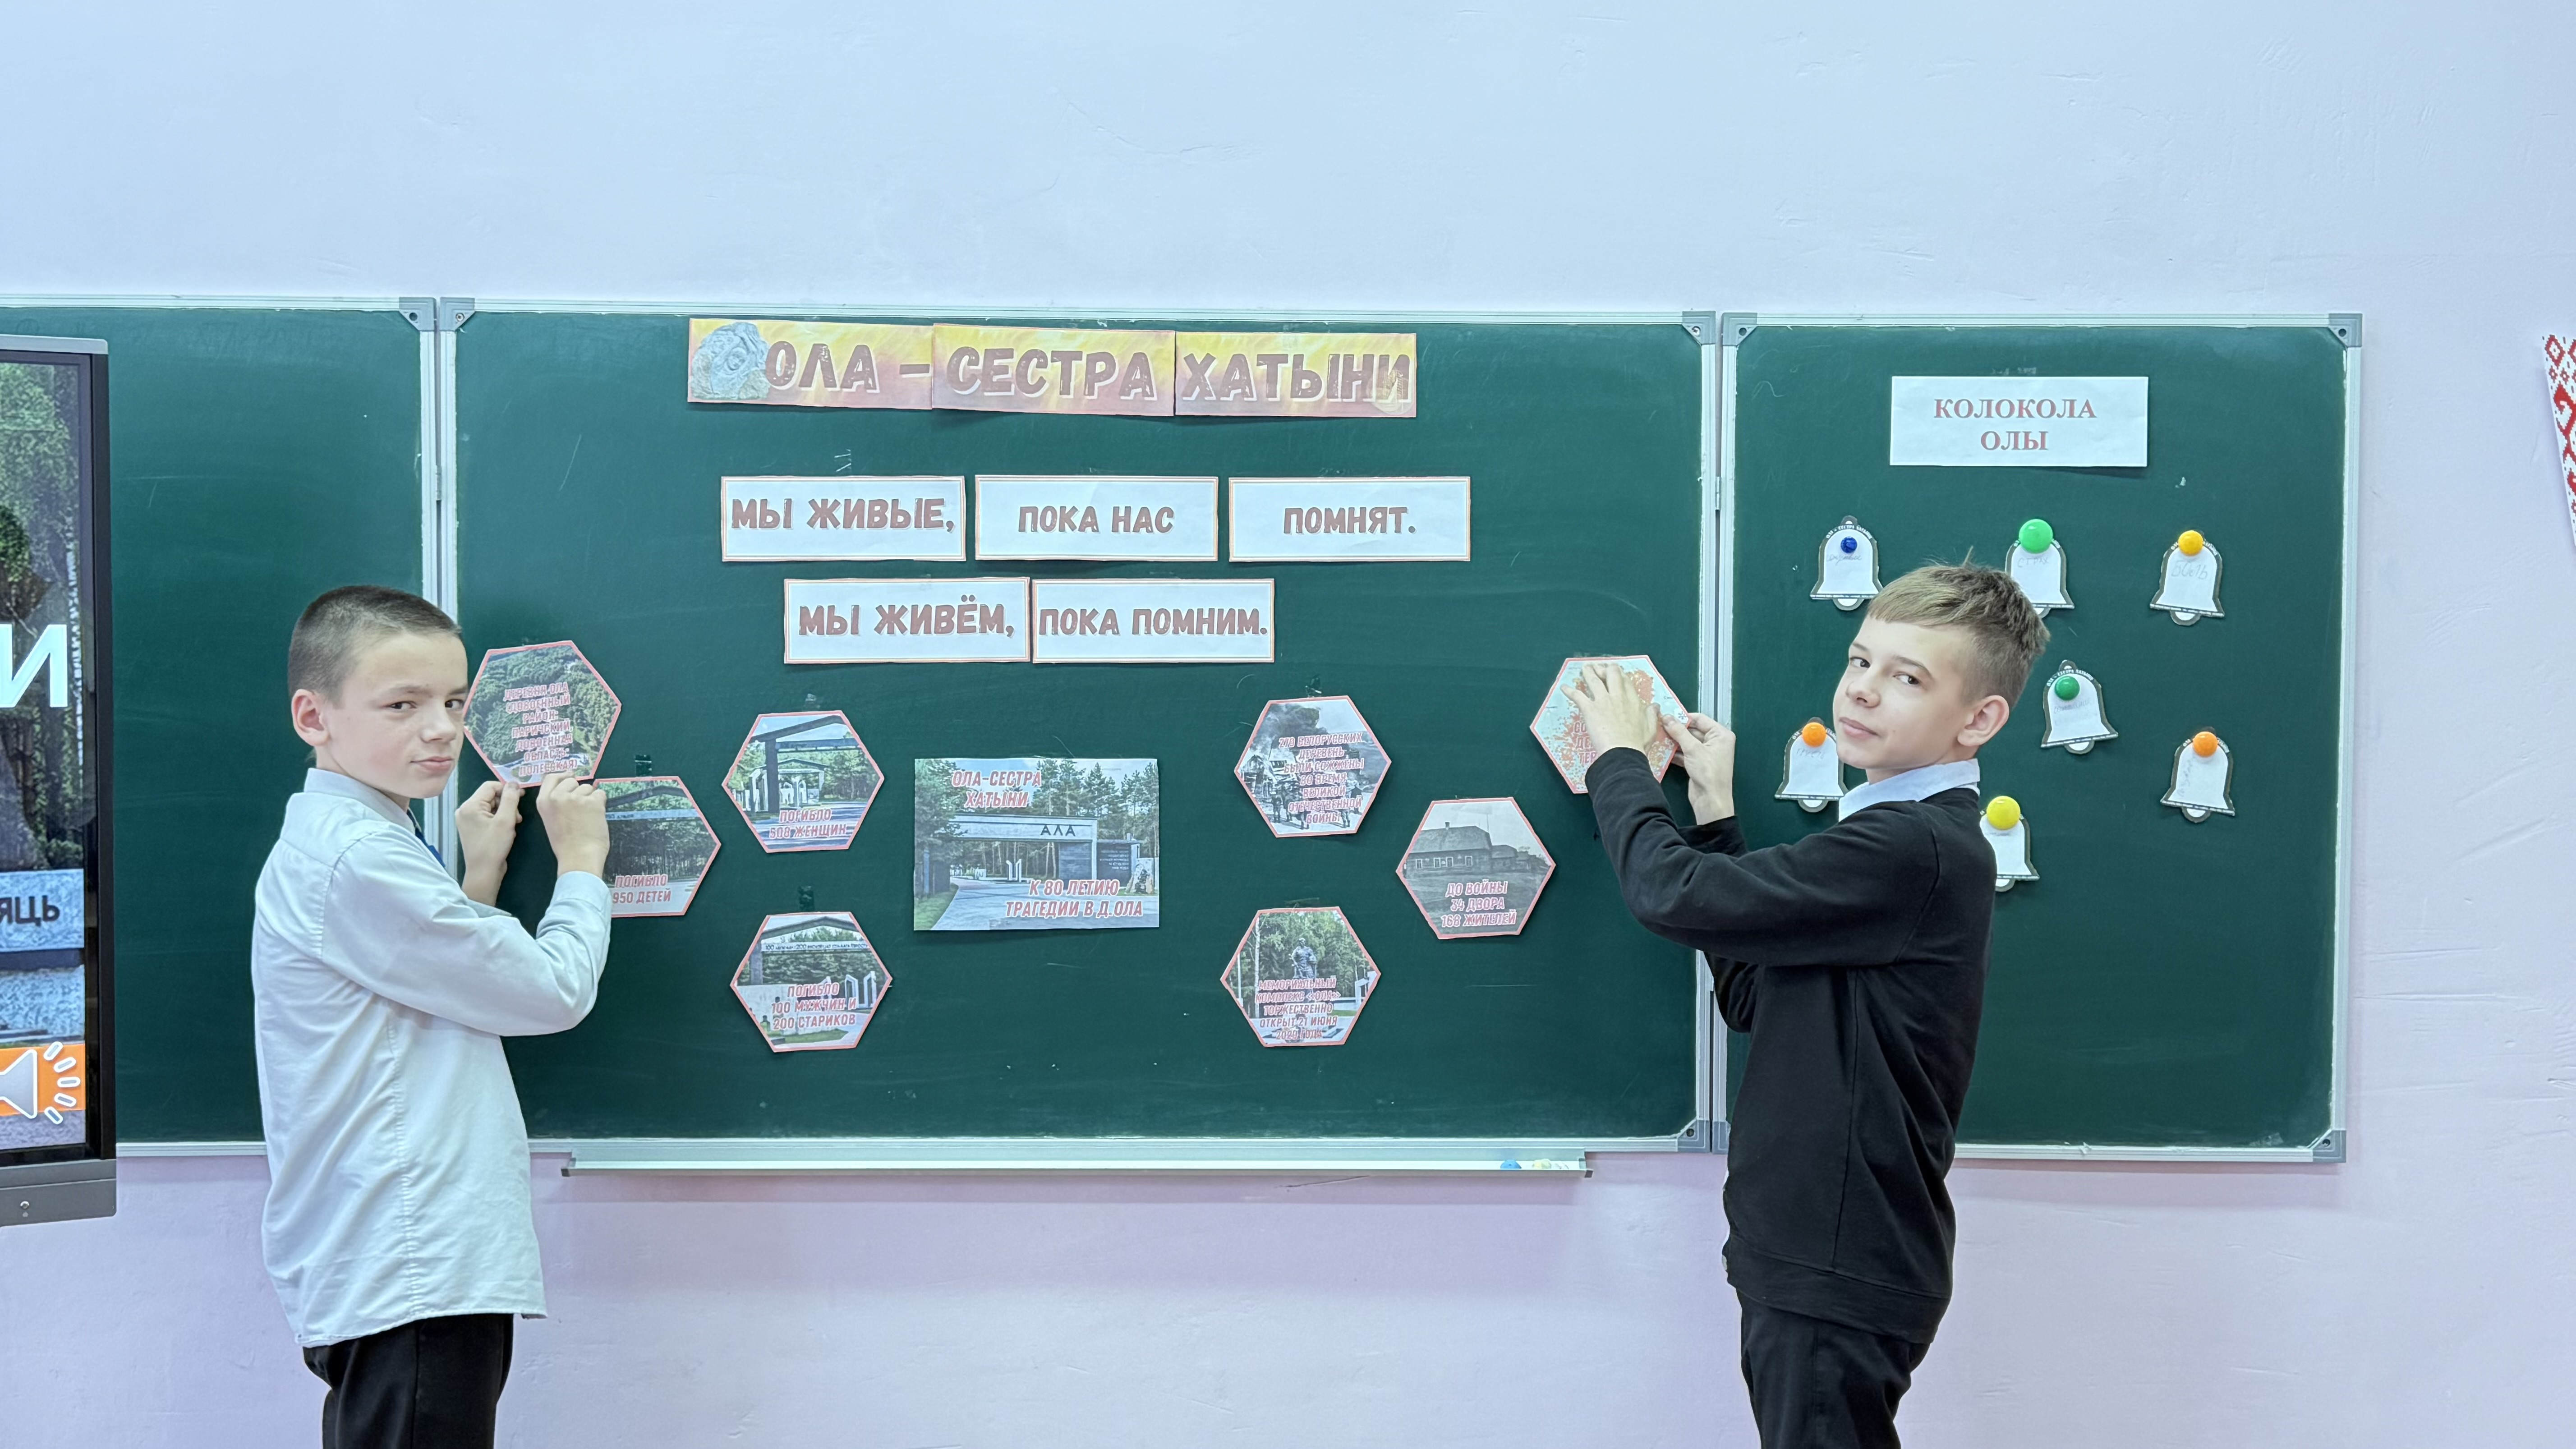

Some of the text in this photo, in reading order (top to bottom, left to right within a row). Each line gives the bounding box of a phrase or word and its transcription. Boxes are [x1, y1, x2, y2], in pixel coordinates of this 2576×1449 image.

[765, 340, 879, 393] ОЛА
[947, 345, 1158, 401] СЕСТРА
[1182, 352, 1412, 403] ХАТЫНИ
[1934, 399, 2097, 419] КОЛОКОЛА
[1981, 431, 2048, 451] ОЛЫ
[731, 498, 1417, 535] МЫ ЖИВЫЕ, ПОКА НАС ПОМНЯТ.
[799, 594, 1268, 638] МЫ ЖИВЁМ, ПОКА ПОМНИМ.
[503, 681, 569, 701] ДЕРЕВНЯ ОЛА
[523, 709, 558, 724] РАЙОН:
[515, 734, 573, 752] ДОВОЕННАЯ
[1297, 732, 1363, 747] БЕЛОРУССКИХ
[1298, 747, 1345, 759] ДЕРЕВЕНЬ
[1284, 758, 1365, 774] БЫЛИ СОЖЖЕНЫ
[1300, 772, 1348, 786] ВО ВРЕМЯ
[964, 791, 1029, 808] ХАТЫНИ
[1302, 785, 1346, 799] ВЕЛИКОЙ
[1288, 795, 1362, 812] ОТЕЧЕСТВЕННОЙ
[779, 809, 833, 823] ПОГИБЛО
[1306, 811, 1341, 824] ВОЙНЫ
[769, 823, 847, 839] 508 ЖЕНЩИН
[1040, 824, 1076, 837] АЛА
[615, 874, 668, 888] ПОГИБЛО
[1030, 879, 1121, 896] К 80 ЛЕТИЮ
[1445, 879, 1508, 898] ДО ВОЙНЫ
[613, 888, 672, 904] 950 ДЕТЕЙ
[1006, 901, 1081, 919] ТРАГЕДИИ
[1083, 901, 1094, 917] В
[1450, 897, 1505, 912] 34 ДВОРА
[1441, 909, 1517, 928] 168 ЖИТЕЛЕЙ
[787, 982, 840, 997] ПОГИБЛО
[1259, 975, 1337, 991] МЕМОРИАЛЬНЫЙ
[772, 997, 857, 1014] 100 МУЖЧИН И
[1255, 991, 1305, 1004] КОМПЛЕКС
[1263, 1002, 1334, 1016] ТОРЖЕСТВЕННО
[773, 1013, 856, 1030] 200 СТАРИКОВ
[1260, 1015, 1338, 1028] ОТКРЫТ 21 ИЮНЯ
[1300, 1028, 1323, 1040] ГОДА
